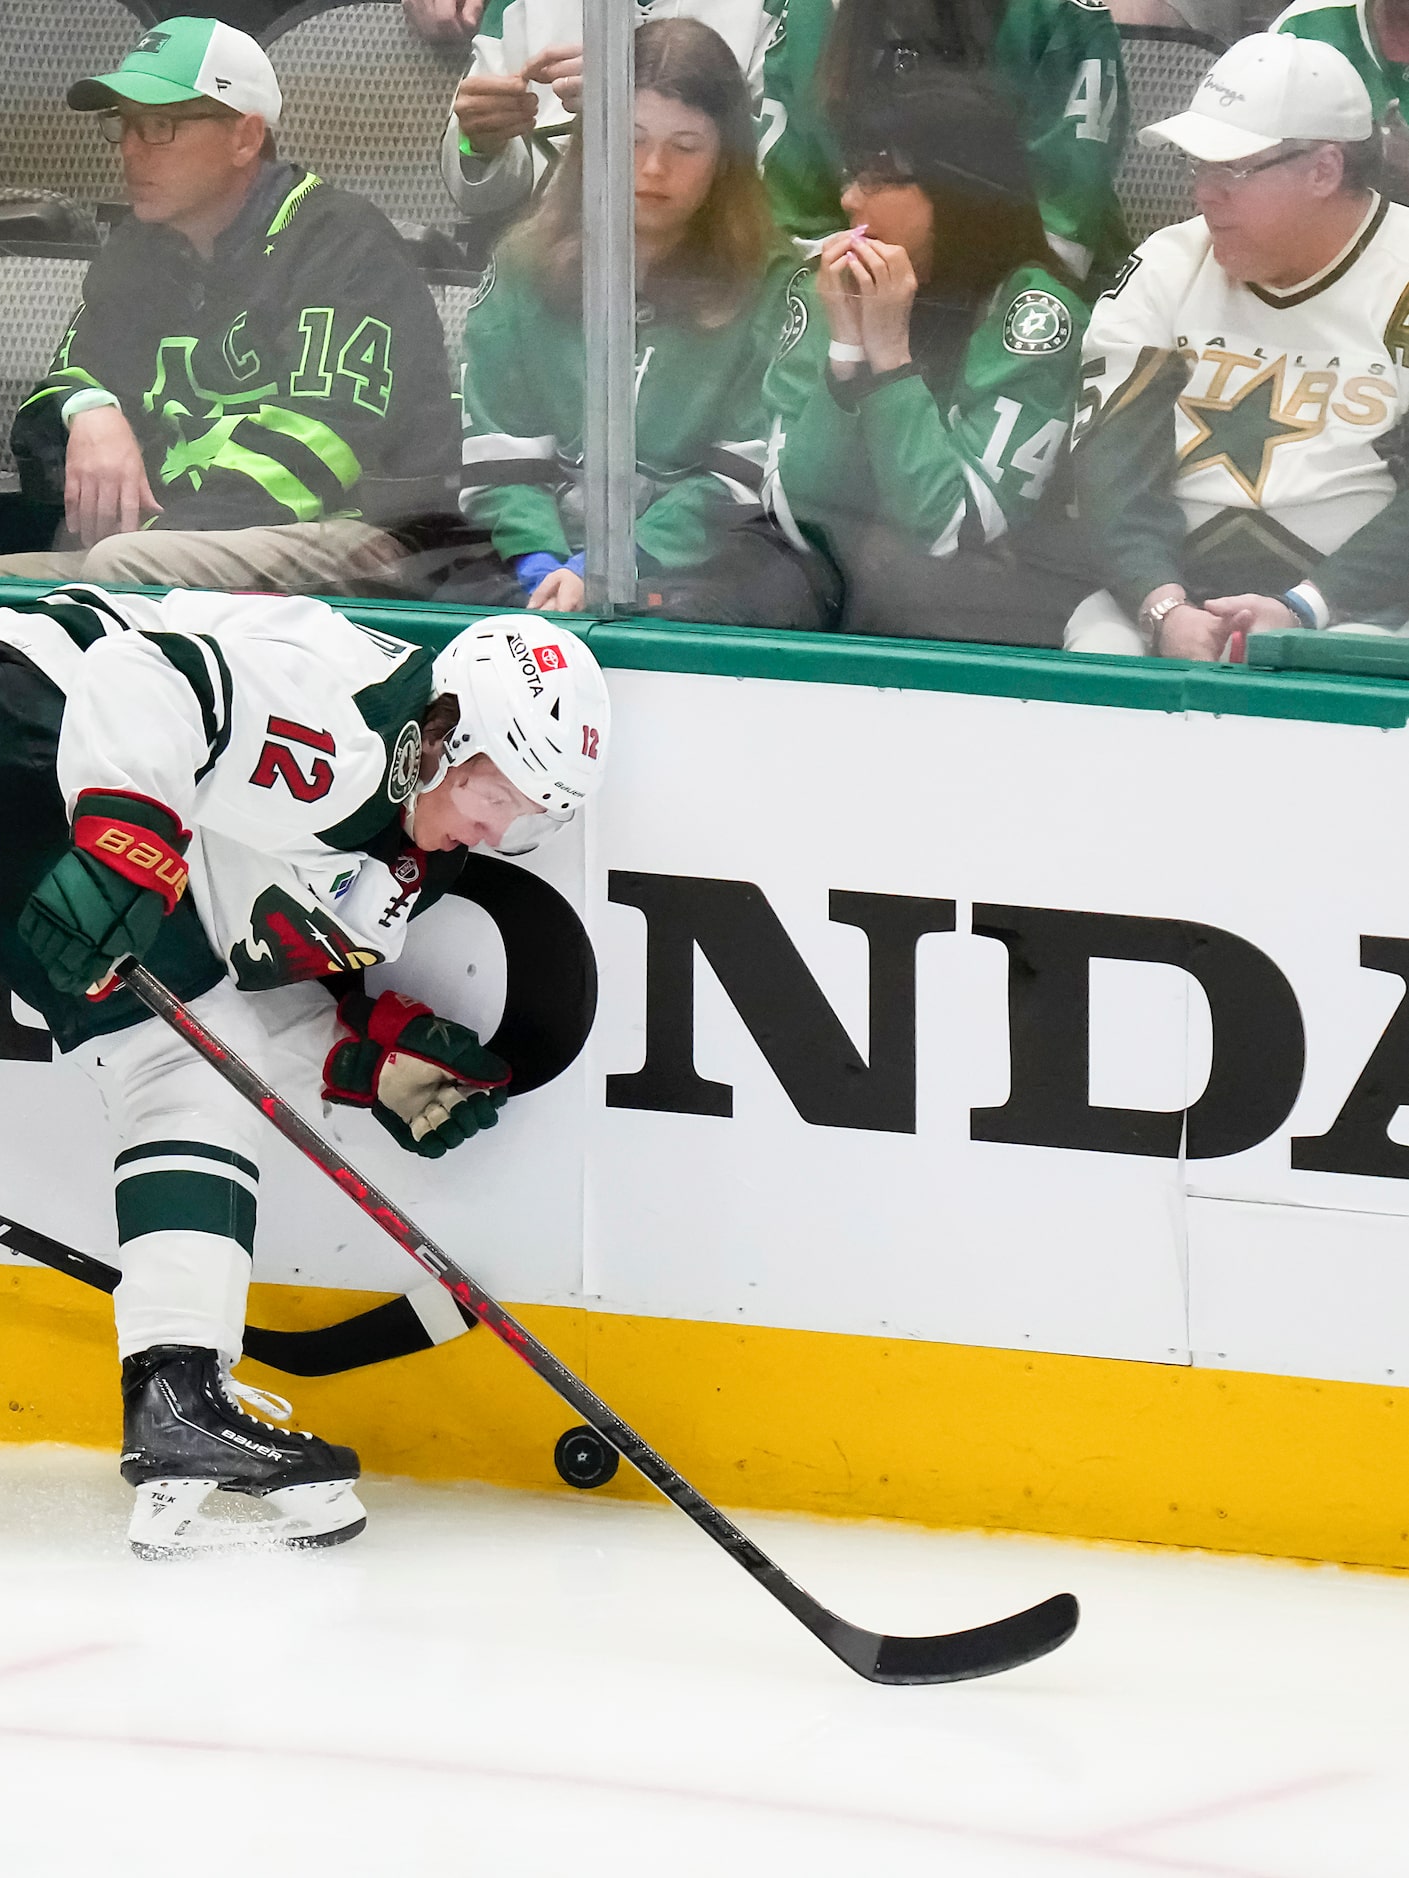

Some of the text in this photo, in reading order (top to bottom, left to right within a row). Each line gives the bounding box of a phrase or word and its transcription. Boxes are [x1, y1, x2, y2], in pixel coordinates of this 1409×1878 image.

[290, 306, 393, 418] 14
[1176, 335, 1386, 376] DALLAS
[1177, 349, 1398, 440] TARS
[976, 395, 1069, 501] 14
[511, 632, 545, 699] TOYOTA
[248, 714, 337, 804] 12
[581, 724, 600, 761] 12
[221, 1428, 283, 1462] BAUER
